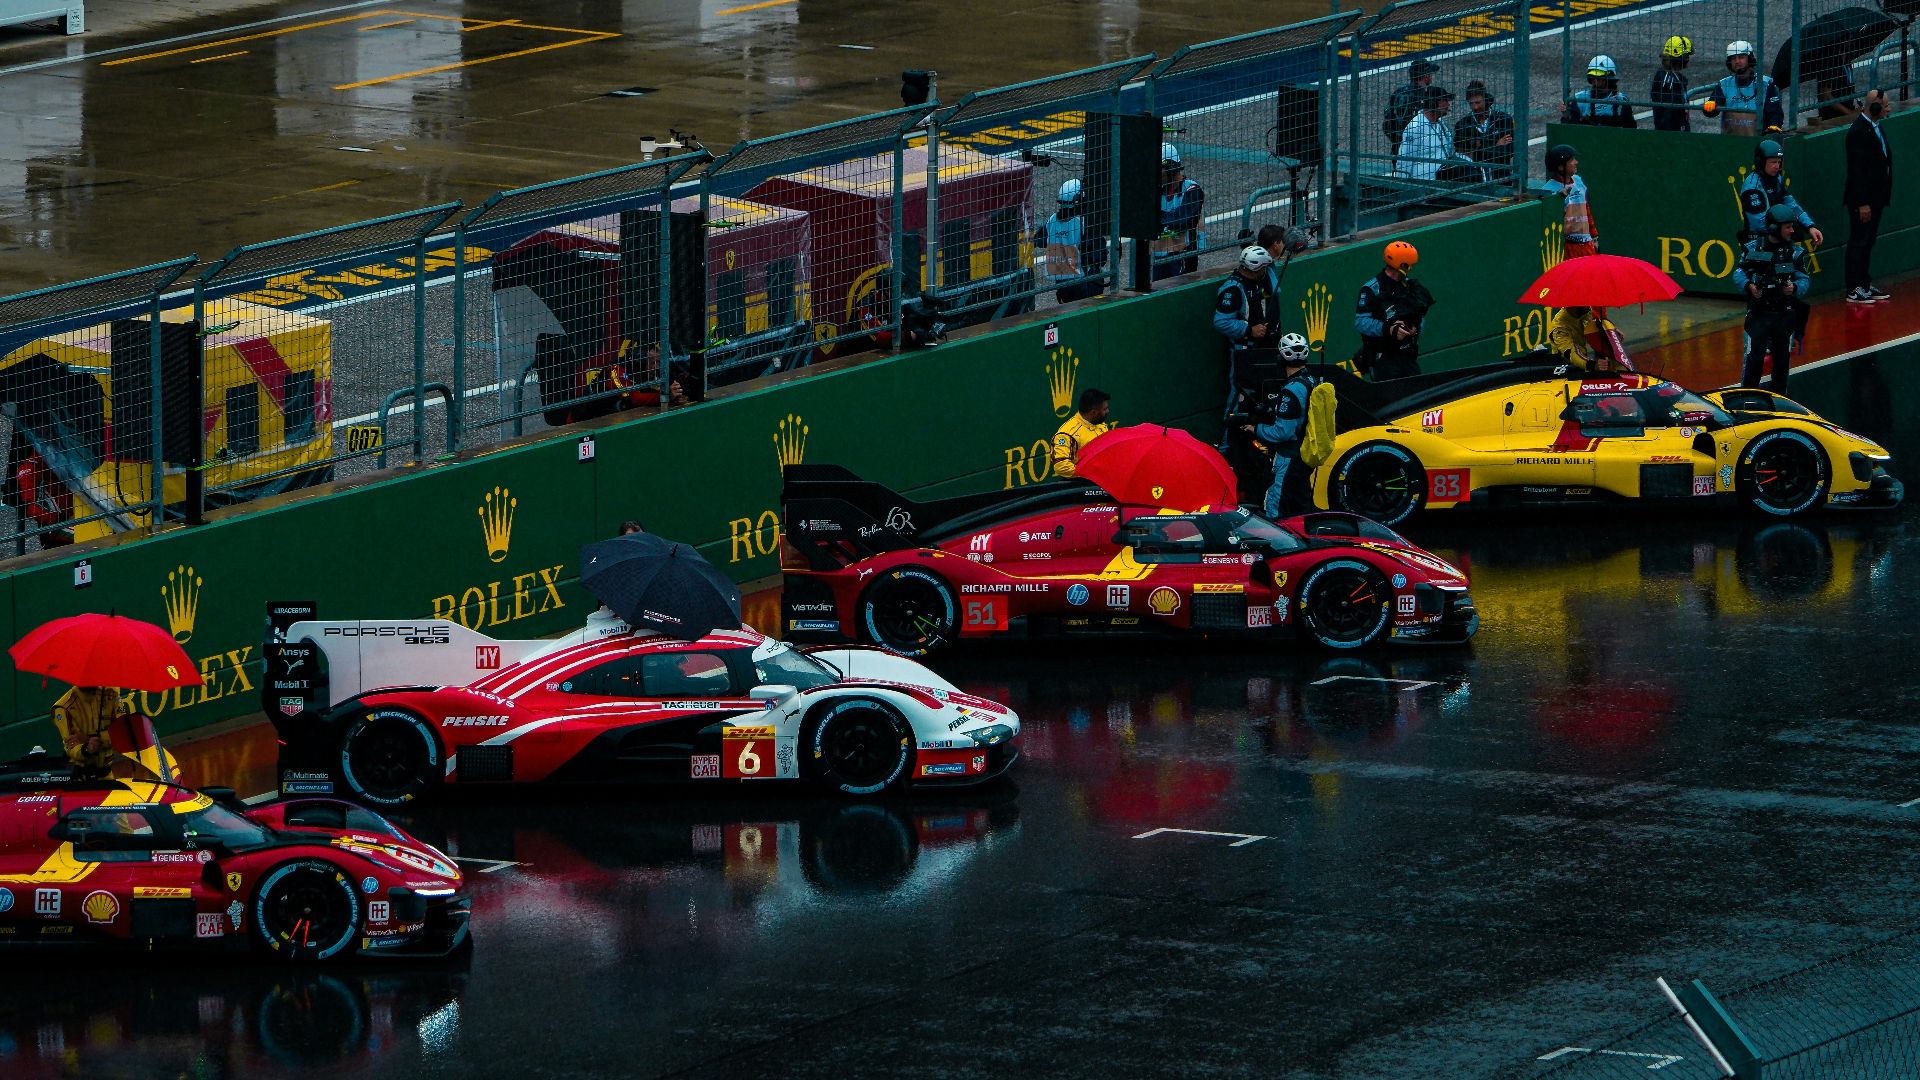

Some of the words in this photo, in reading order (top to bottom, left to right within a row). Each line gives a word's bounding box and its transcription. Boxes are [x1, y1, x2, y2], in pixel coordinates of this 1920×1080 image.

[1581, 383, 1612, 391] ORLEN
[1423, 411, 1443, 426] HY
[582, 444, 590, 456] 51
[1516, 457, 1561, 465] RICHARD
[1649, 455, 1683, 463] DHL
[1433, 474, 1461, 497] 83
[1694, 484, 1716, 494] CAR
[970, 533, 992, 551] HY
[1030, 532, 1052, 541] AT&T
[80, 569, 86, 580] 6
[961, 584, 1012, 593] RICHARD
[1015, 583, 1049, 592] MILLE
[1200, 584, 1237, 592] DHL
[431, 565, 566, 631] ROLEX
[1069, 585, 1086, 603] hp
[791, 601, 835, 611] VISTAJET
[967, 601, 997, 625] 51
[1249, 615, 1272, 626] CAR
[324, 626, 450, 637] PORSCHE
[600, 626, 620, 636] Mobil
[404, 637, 450, 645] 963
[278, 647, 310, 658] Ansys
[475, 647, 500, 669] HY
[274, 680, 299, 689] Mobil
[458, 686, 516, 708] Ansys
[380, 710, 418, 724] MICHELIN
[441, 715, 510, 727] PENSKE
[727, 728, 771, 737] DHL
[815, 711, 834, 747] MICHELIN
[921, 740, 944, 749] Mobil
[692, 756, 718, 764] HYPER
[738, 741, 761, 775] 6
[293, 772, 329, 780] Multimatic
[692, 764, 718, 777] CAR
[158, 854, 194, 863] GENESYS
[142, 887, 185, 897] DHL
[198, 914, 224, 924] HYPER
[198, 923, 225, 936] CAR
